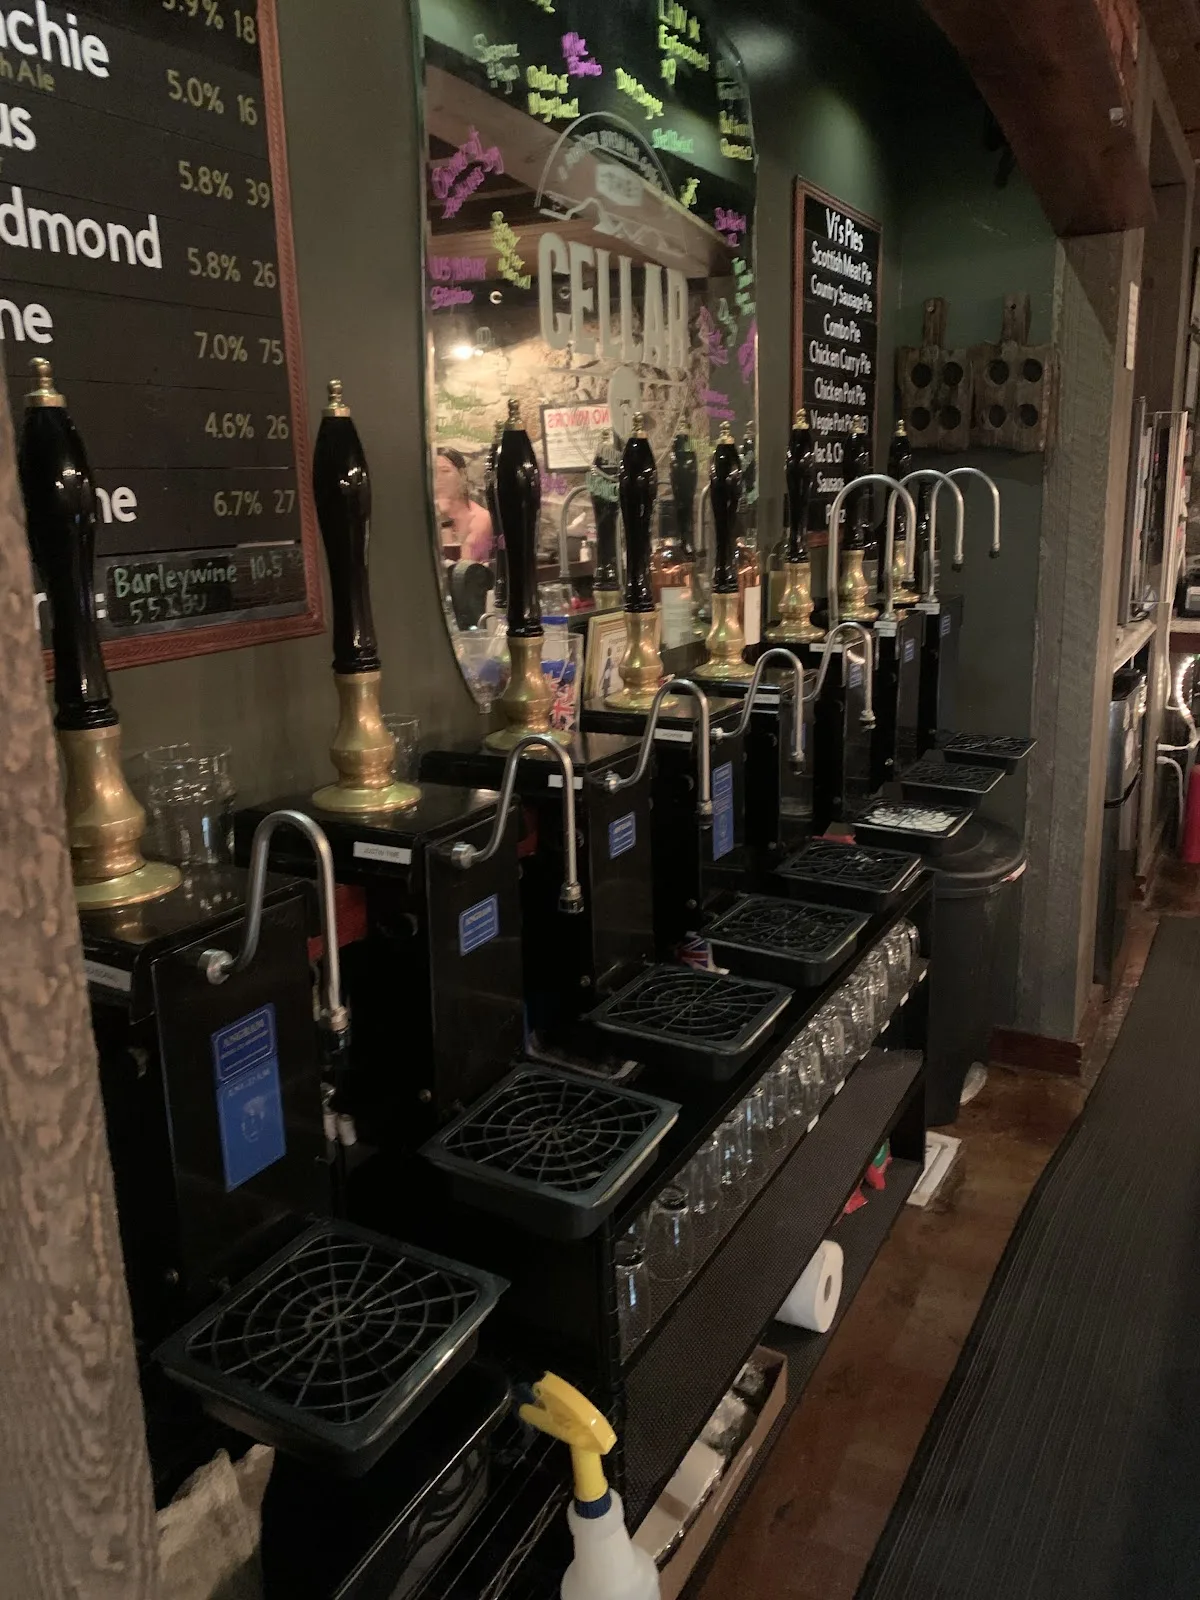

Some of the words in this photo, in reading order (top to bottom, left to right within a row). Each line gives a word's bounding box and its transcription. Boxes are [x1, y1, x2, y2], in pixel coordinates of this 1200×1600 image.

[233, 9, 257, 44] 18
[15, 57, 56, 92] Ale
[166, 69, 225, 115] 5.0%
[236, 94, 258, 126] 16
[178, 160, 234, 200] 5.8%
[245, 178, 273, 209] 39
[844, 218, 864, 253] Pies
[187, 248, 242, 283] 5.8%
[252, 260, 277, 289] 26
[811, 240, 843, 274] Scottish
[843, 252, 862, 282] Meat
[861, 261, 873, 286] Pie
[538, 232, 689, 370] CELLAR
[810, 274, 838, 306] Country
[838, 284, 863, 315] Sausage
[862, 292, 873, 313] Pie
[823, 312, 850, 341] Combo
[849, 320, 861, 344] Pie
[194, 331, 248, 362] 7.0%
[258, 338, 284, 365] 75
[809, 340, 840, 369] Chicken
[840, 347, 861, 377] Curry
[860, 352, 872, 375] Pie
[814, 376, 843, 403] Chicken
[843, 382, 857, 404] Pot
[856, 384, 867, 406] Pie
[205, 412, 254, 439] 4.6%
[266, 415, 289, 440] 26
[810, 409, 834, 436] Veggie
[213, 490, 263, 518] 6.7%
[273, 488, 296, 515] 27
[114, 558, 239, 598] Barleywine
